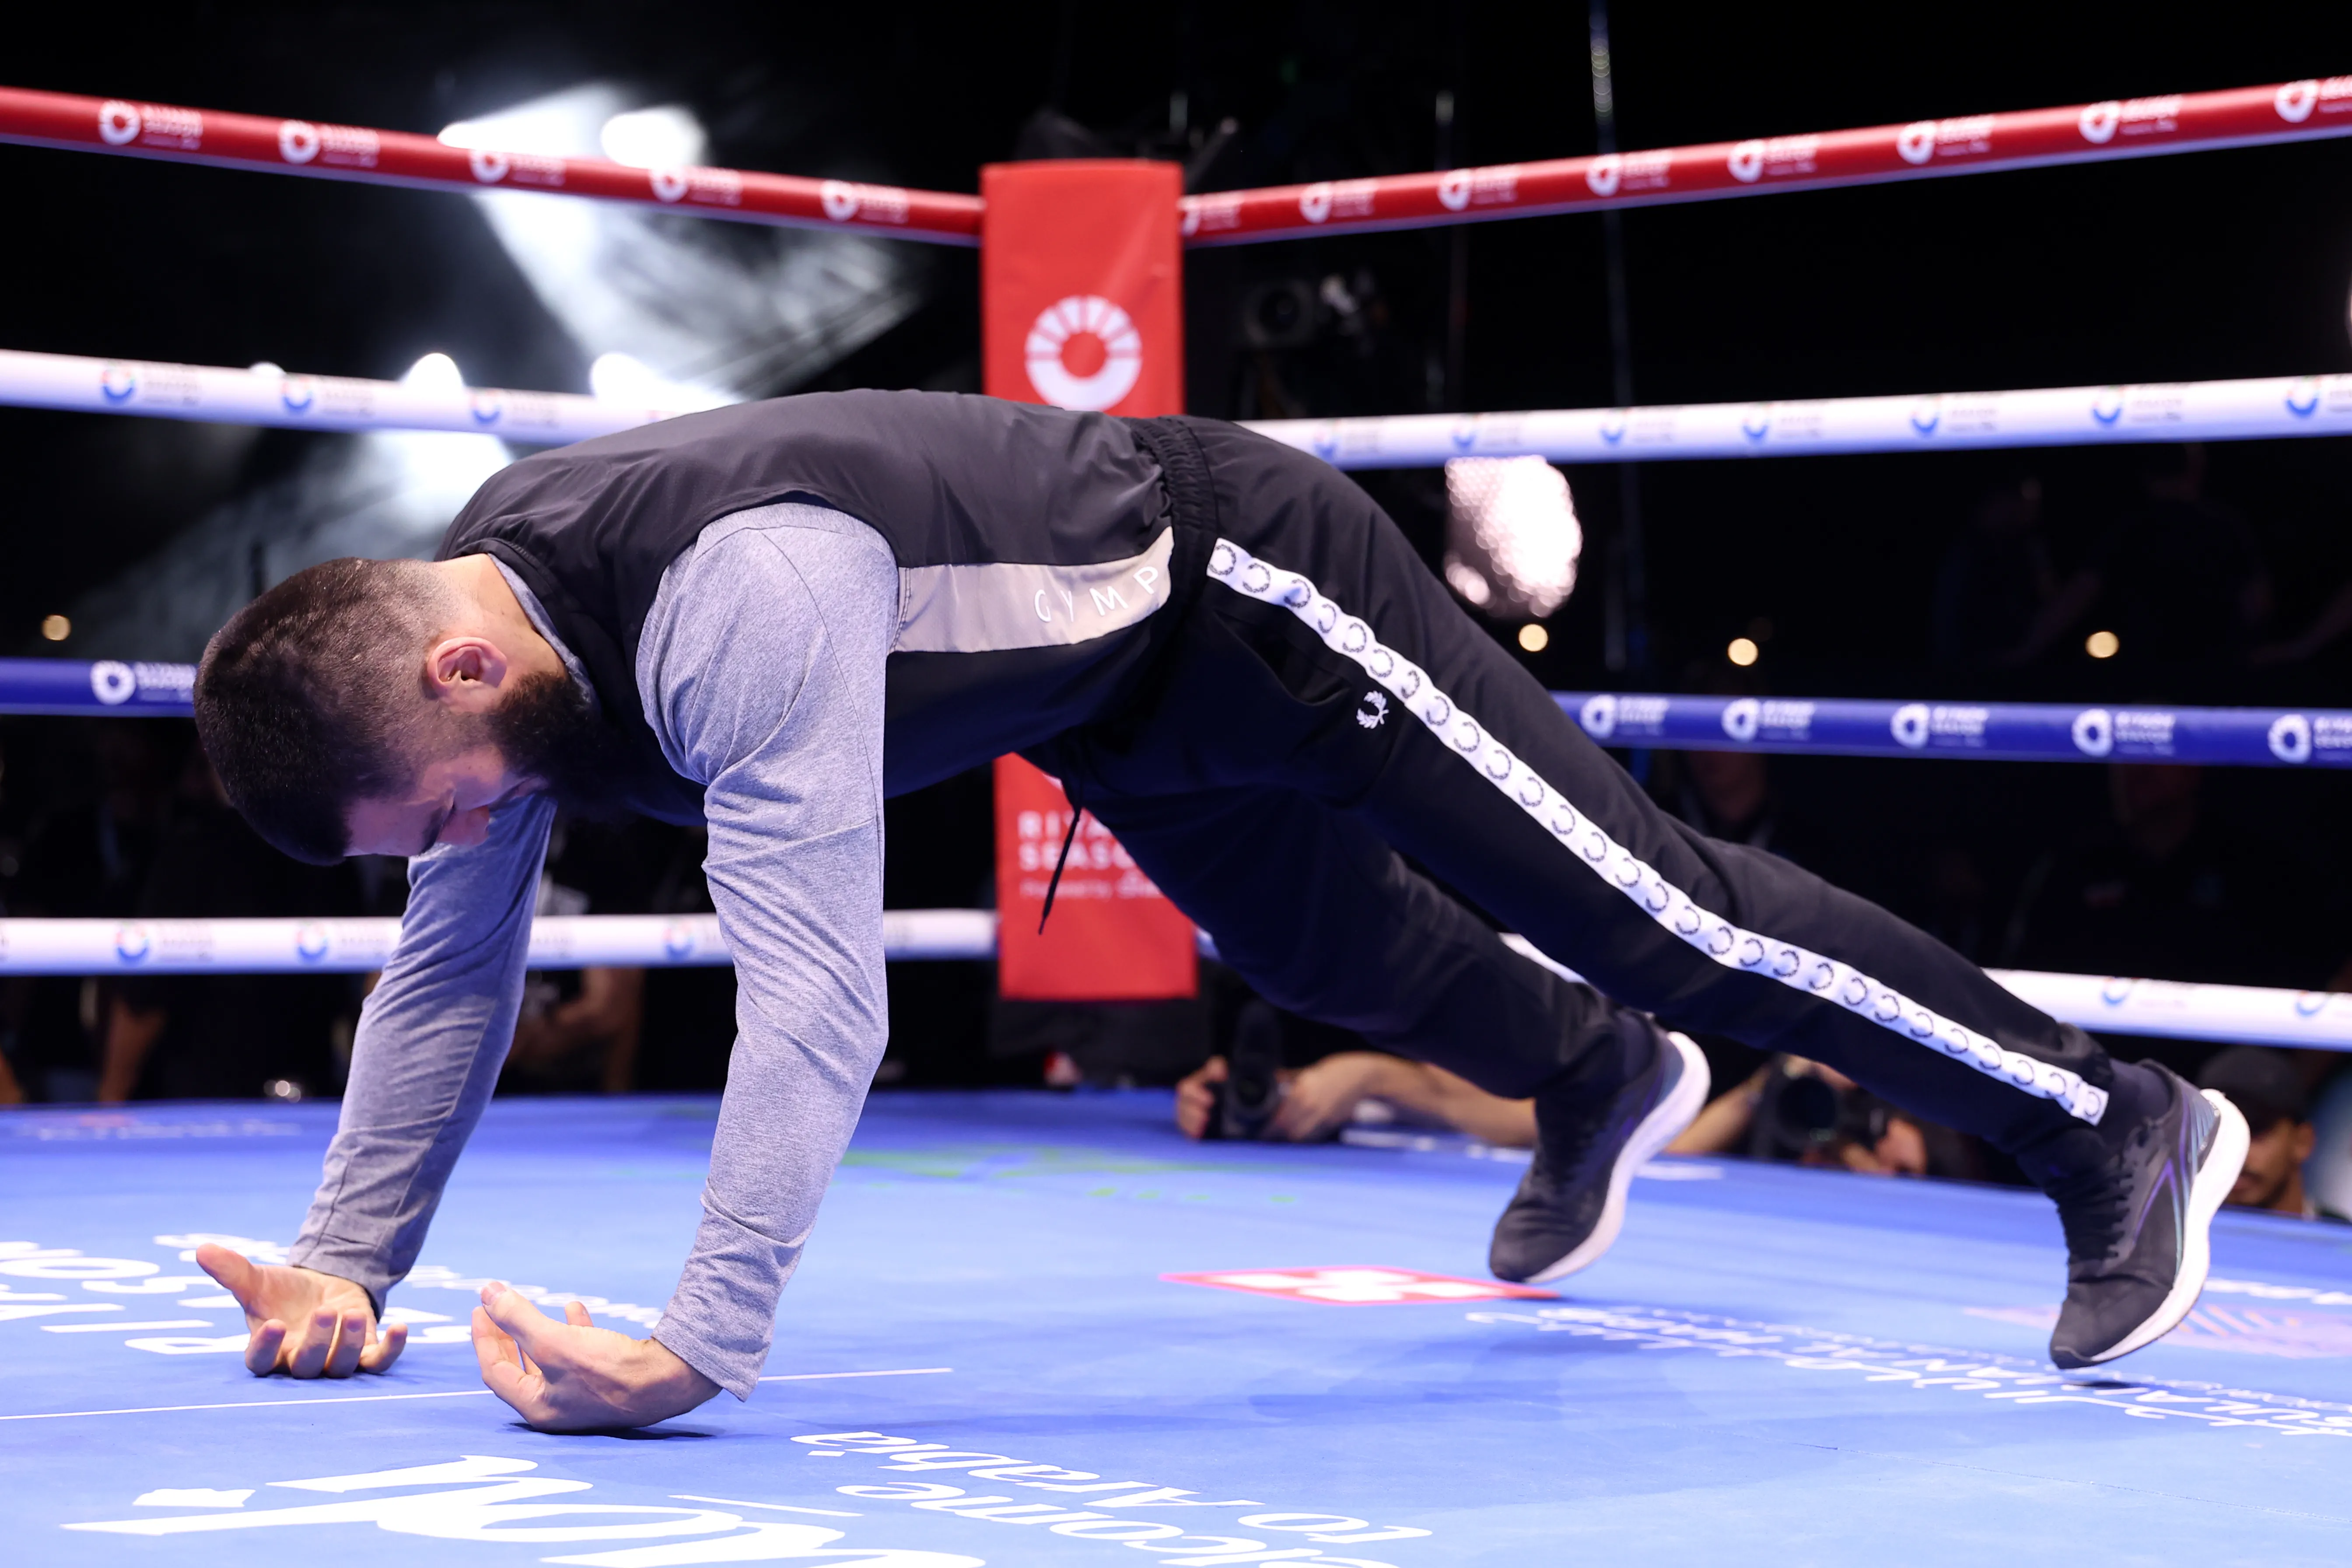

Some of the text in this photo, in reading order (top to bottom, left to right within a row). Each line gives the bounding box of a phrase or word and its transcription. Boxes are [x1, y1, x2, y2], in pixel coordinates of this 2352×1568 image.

[1018, 842, 1136, 871] SEASO
[791, 1431, 1433, 1544] to Arabia
[836, 1481, 1401, 1568] elcome
